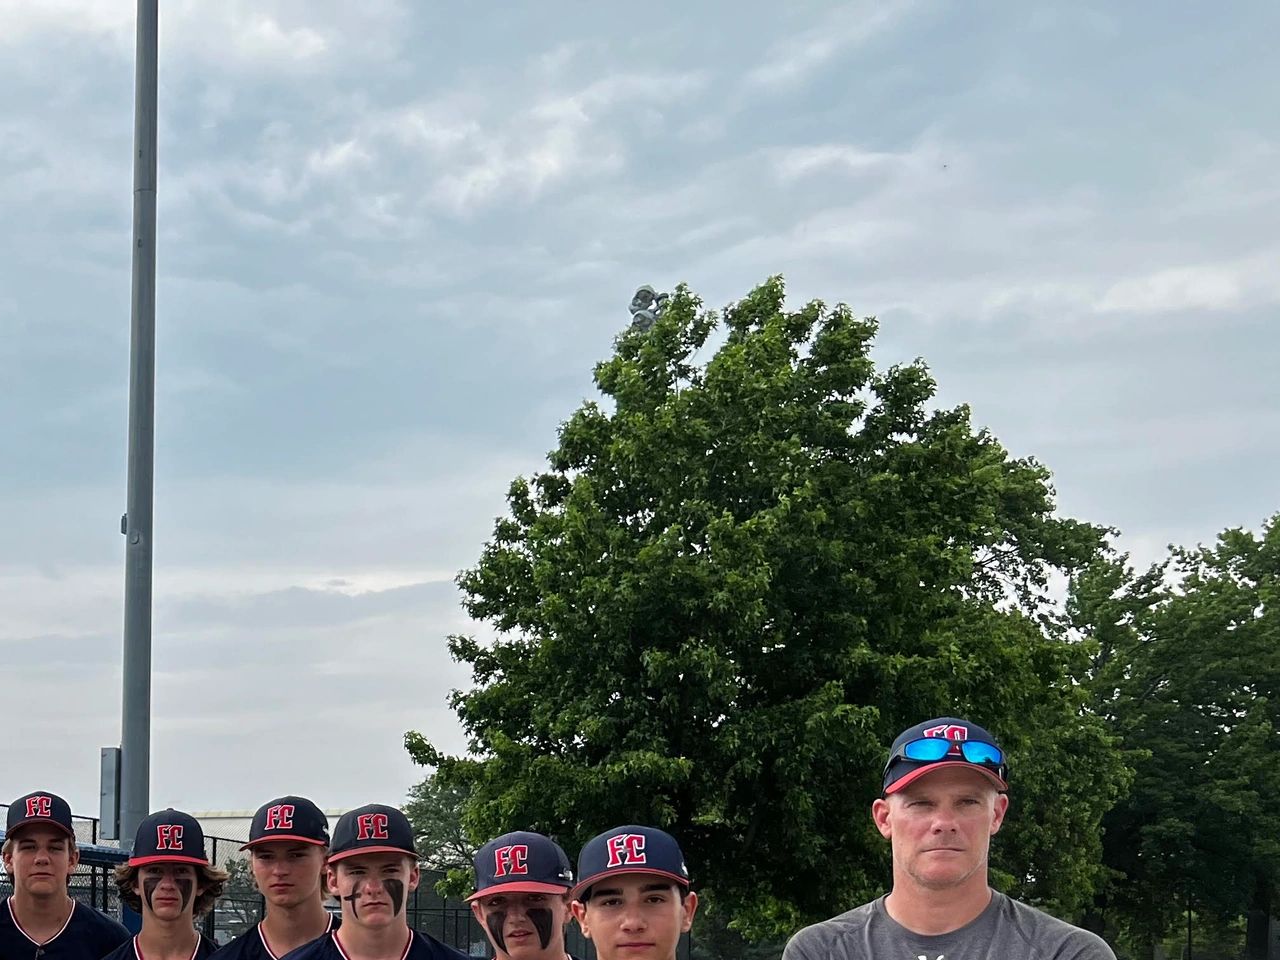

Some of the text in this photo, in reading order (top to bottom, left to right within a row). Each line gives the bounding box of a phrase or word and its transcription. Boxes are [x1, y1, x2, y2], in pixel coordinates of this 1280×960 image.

[25, 796, 51, 818] FC
[264, 804, 295, 831] FC
[156, 825, 183, 850] FC
[357, 813, 389, 841] FC
[494, 844, 528, 878] FC
[607, 833, 647, 868] FC
